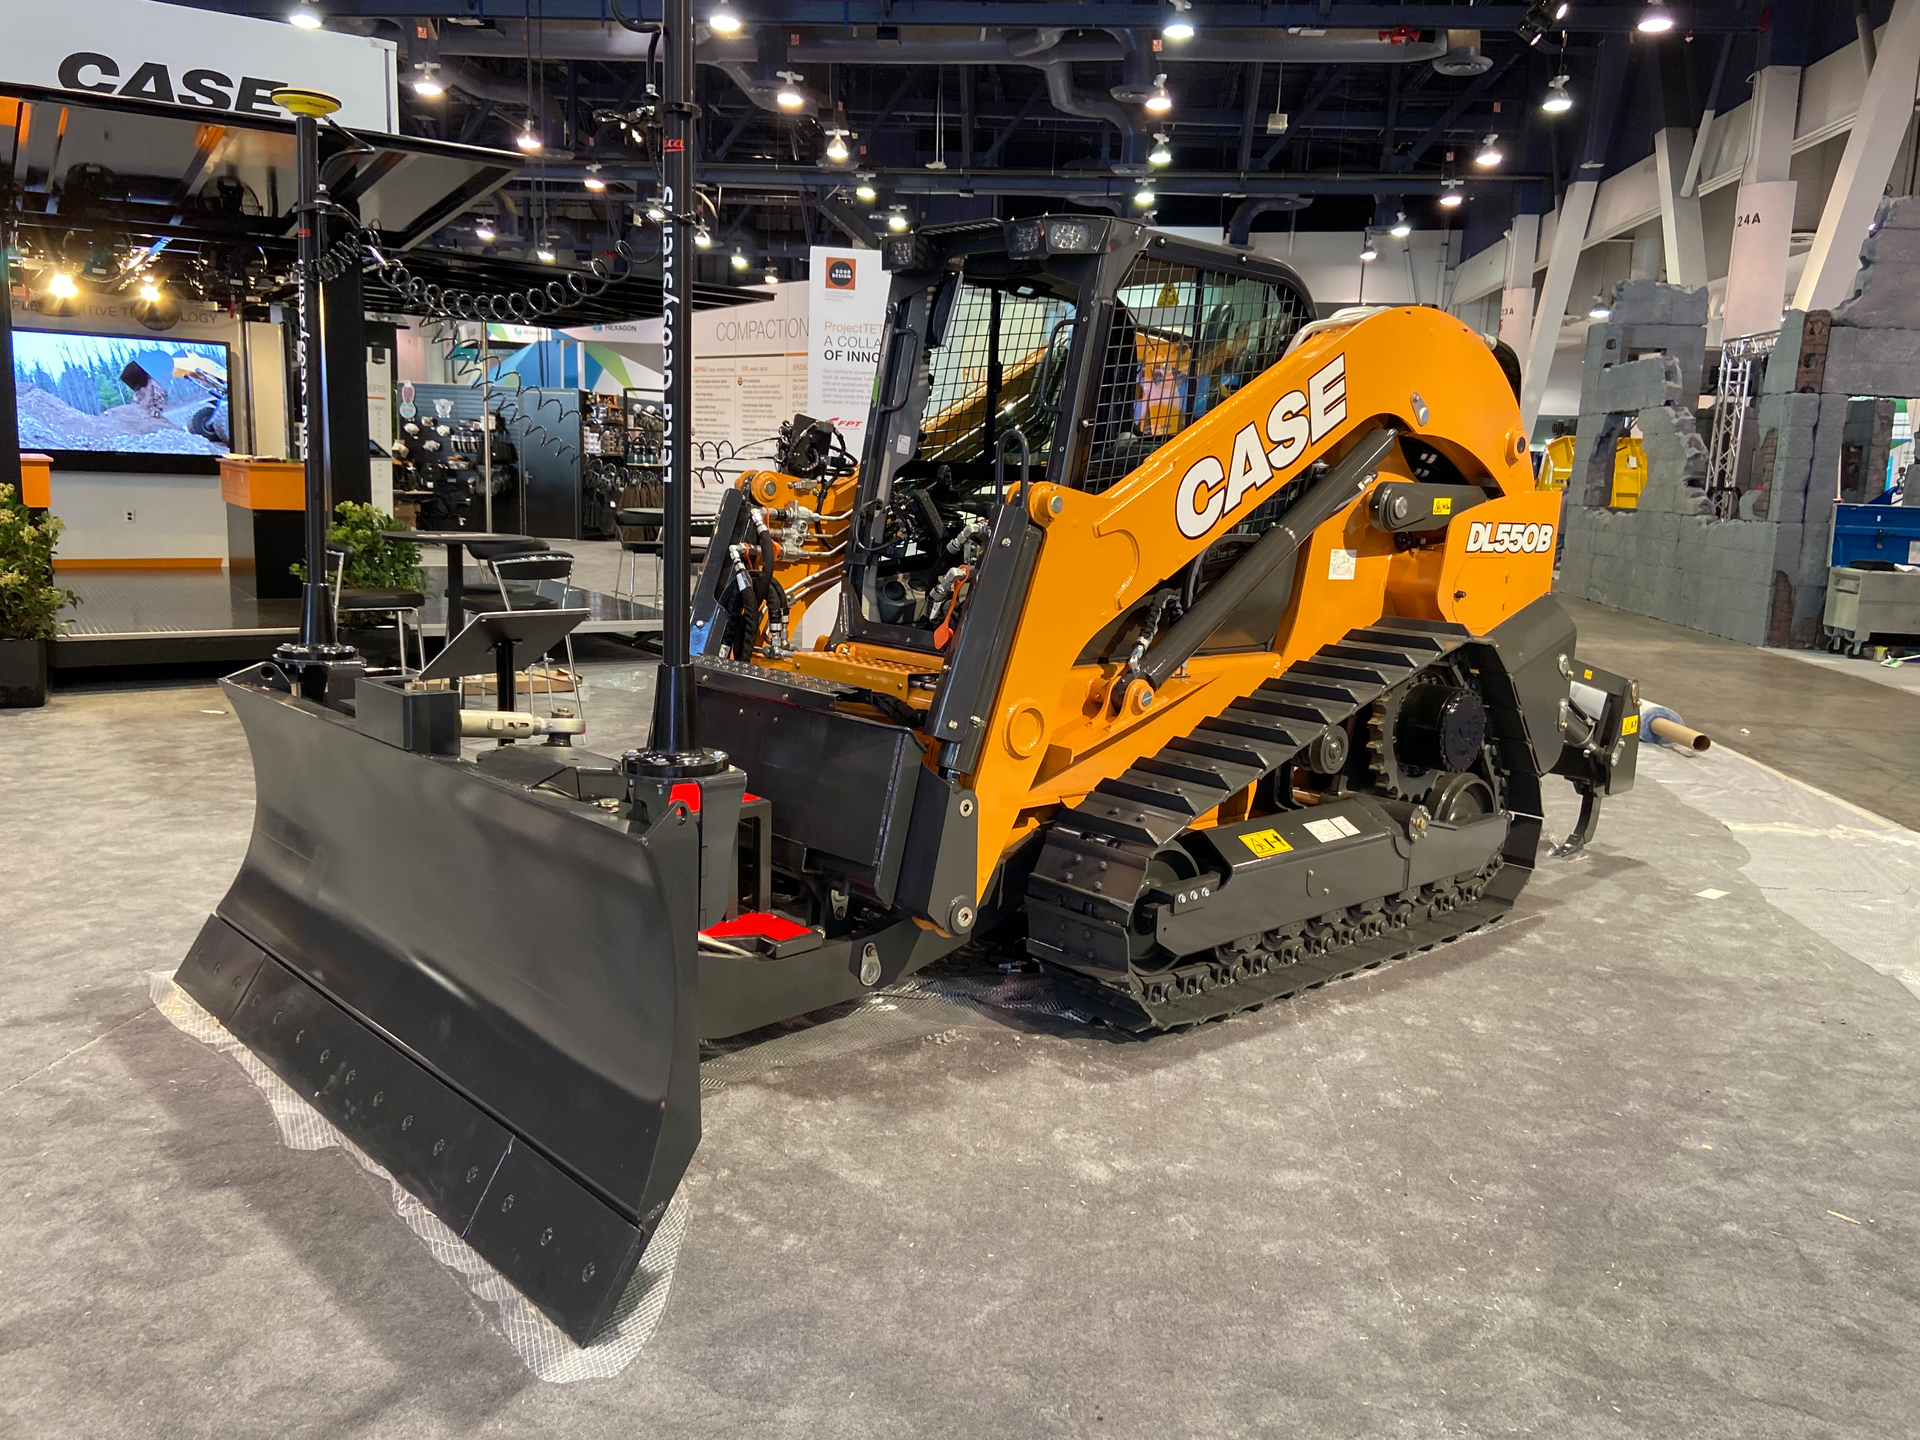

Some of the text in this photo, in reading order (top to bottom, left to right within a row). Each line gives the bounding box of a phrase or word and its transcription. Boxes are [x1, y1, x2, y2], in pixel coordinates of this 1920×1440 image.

[57, 51, 289, 117] CASE
[663, 135, 685, 152] ica
[716, 317, 810, 342] COMPACTION
[824, 321, 884, 334] ProjectTET
[824, 336, 882, 349] A COLLA
[824, 350, 880, 363] OF INNO
[368, 384, 386, 394] ERS
[1175, 351, 1348, 540] CASE
[1465, 521, 1554, 554] DL550B
